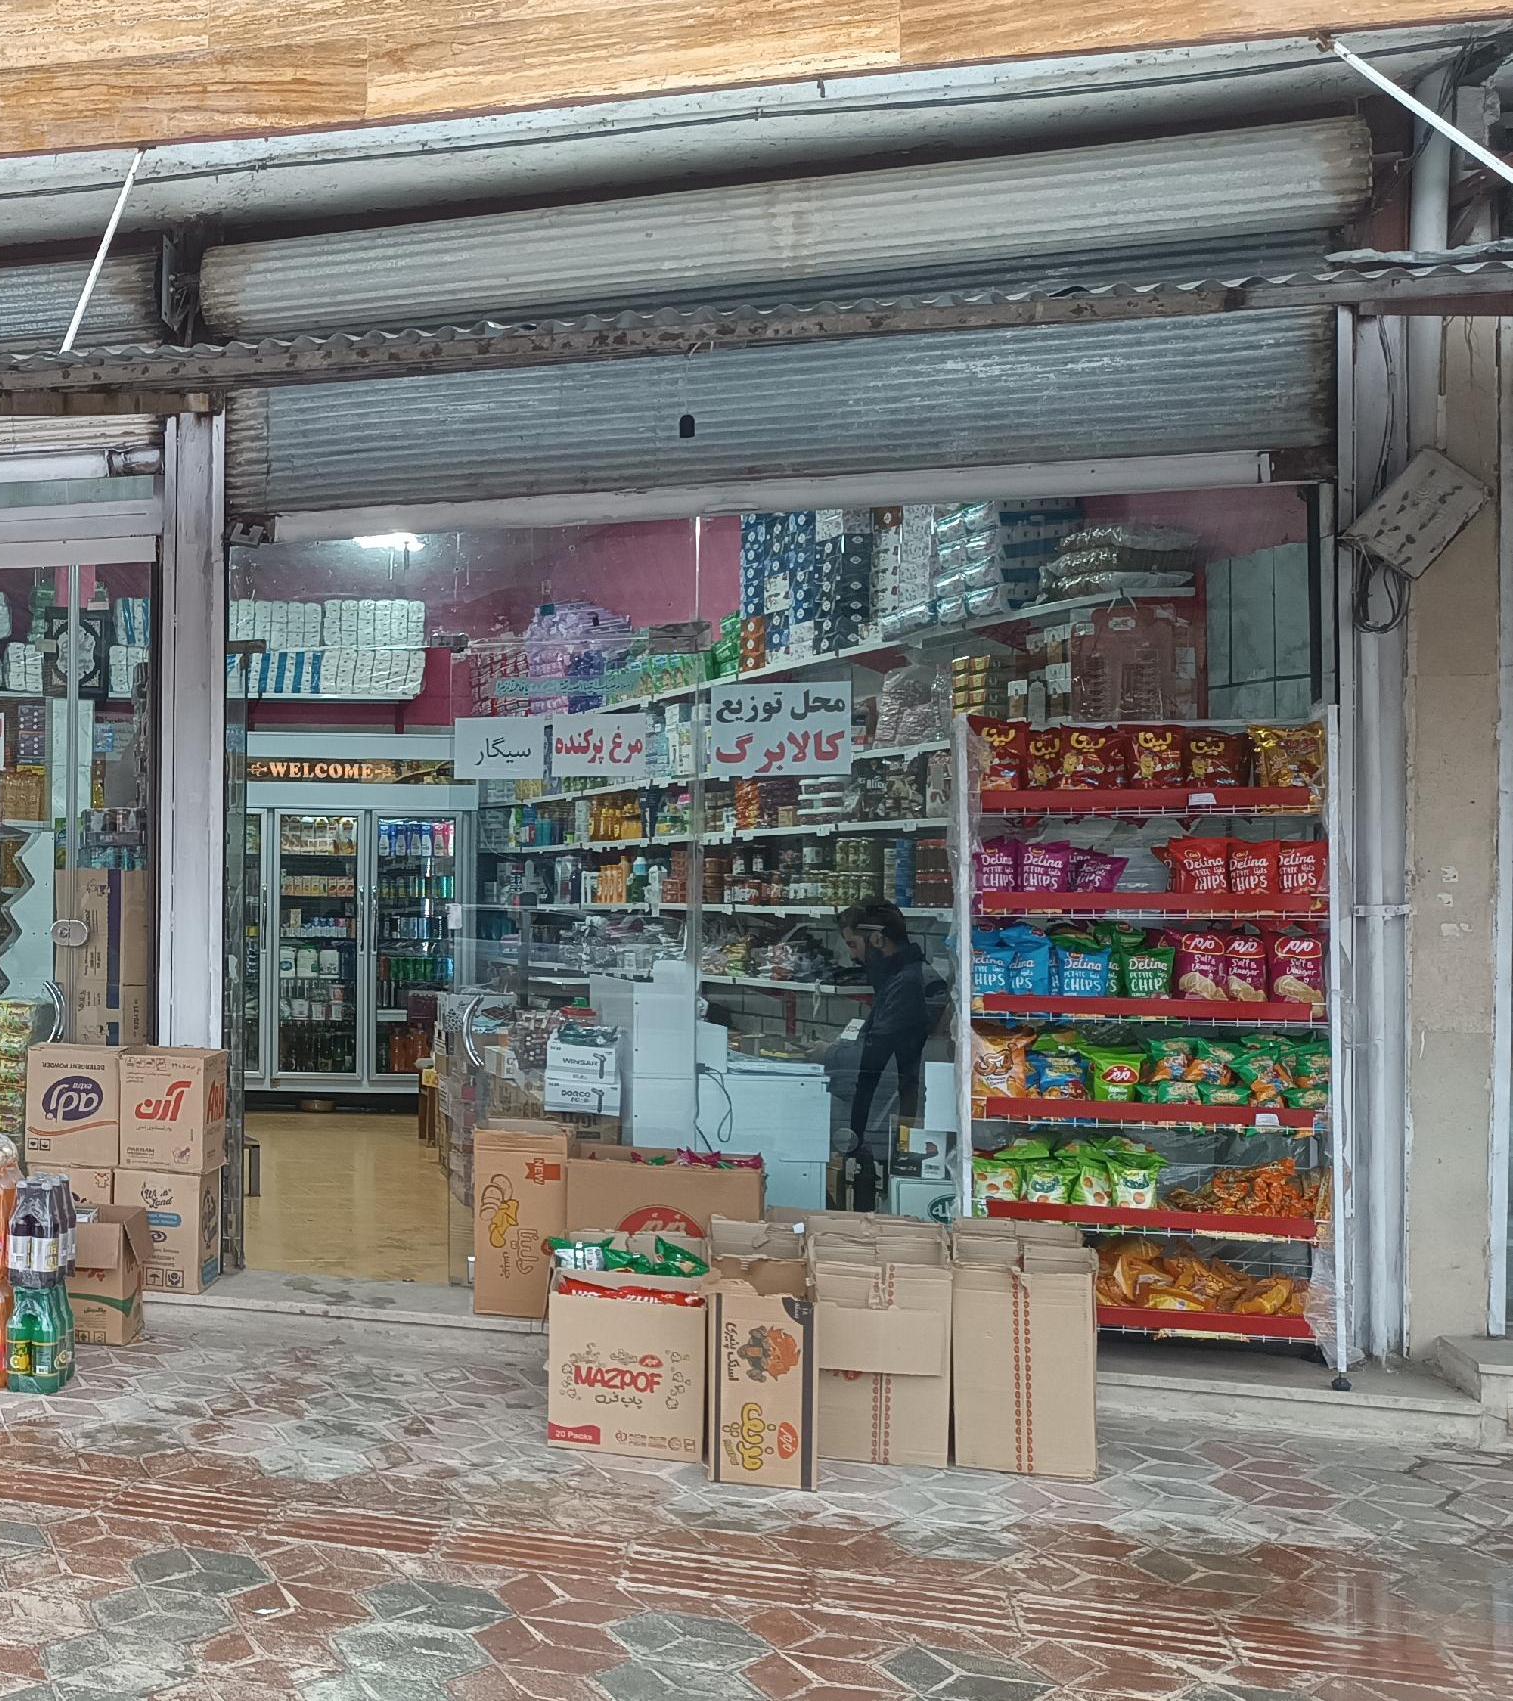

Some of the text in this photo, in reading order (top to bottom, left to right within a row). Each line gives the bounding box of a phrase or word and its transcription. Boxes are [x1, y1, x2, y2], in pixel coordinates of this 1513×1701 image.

[716, 689, 845, 723] محل توزیع
[475, 738, 531, 766] سیگار
[555, 725, 643, 764] مرغ پرکنده
[269, 762, 374, 779] WELCOME
[1064, 958, 1101, 970] Delina
[1128, 956, 1168, 970] Delina
[1064, 978, 1101, 992] CHIPS
[534, 1158, 545, 1186] NEW
[574, 1365, 663, 1393] MAZPOF
[555, 1430, 593, 1440] 20 Packs
